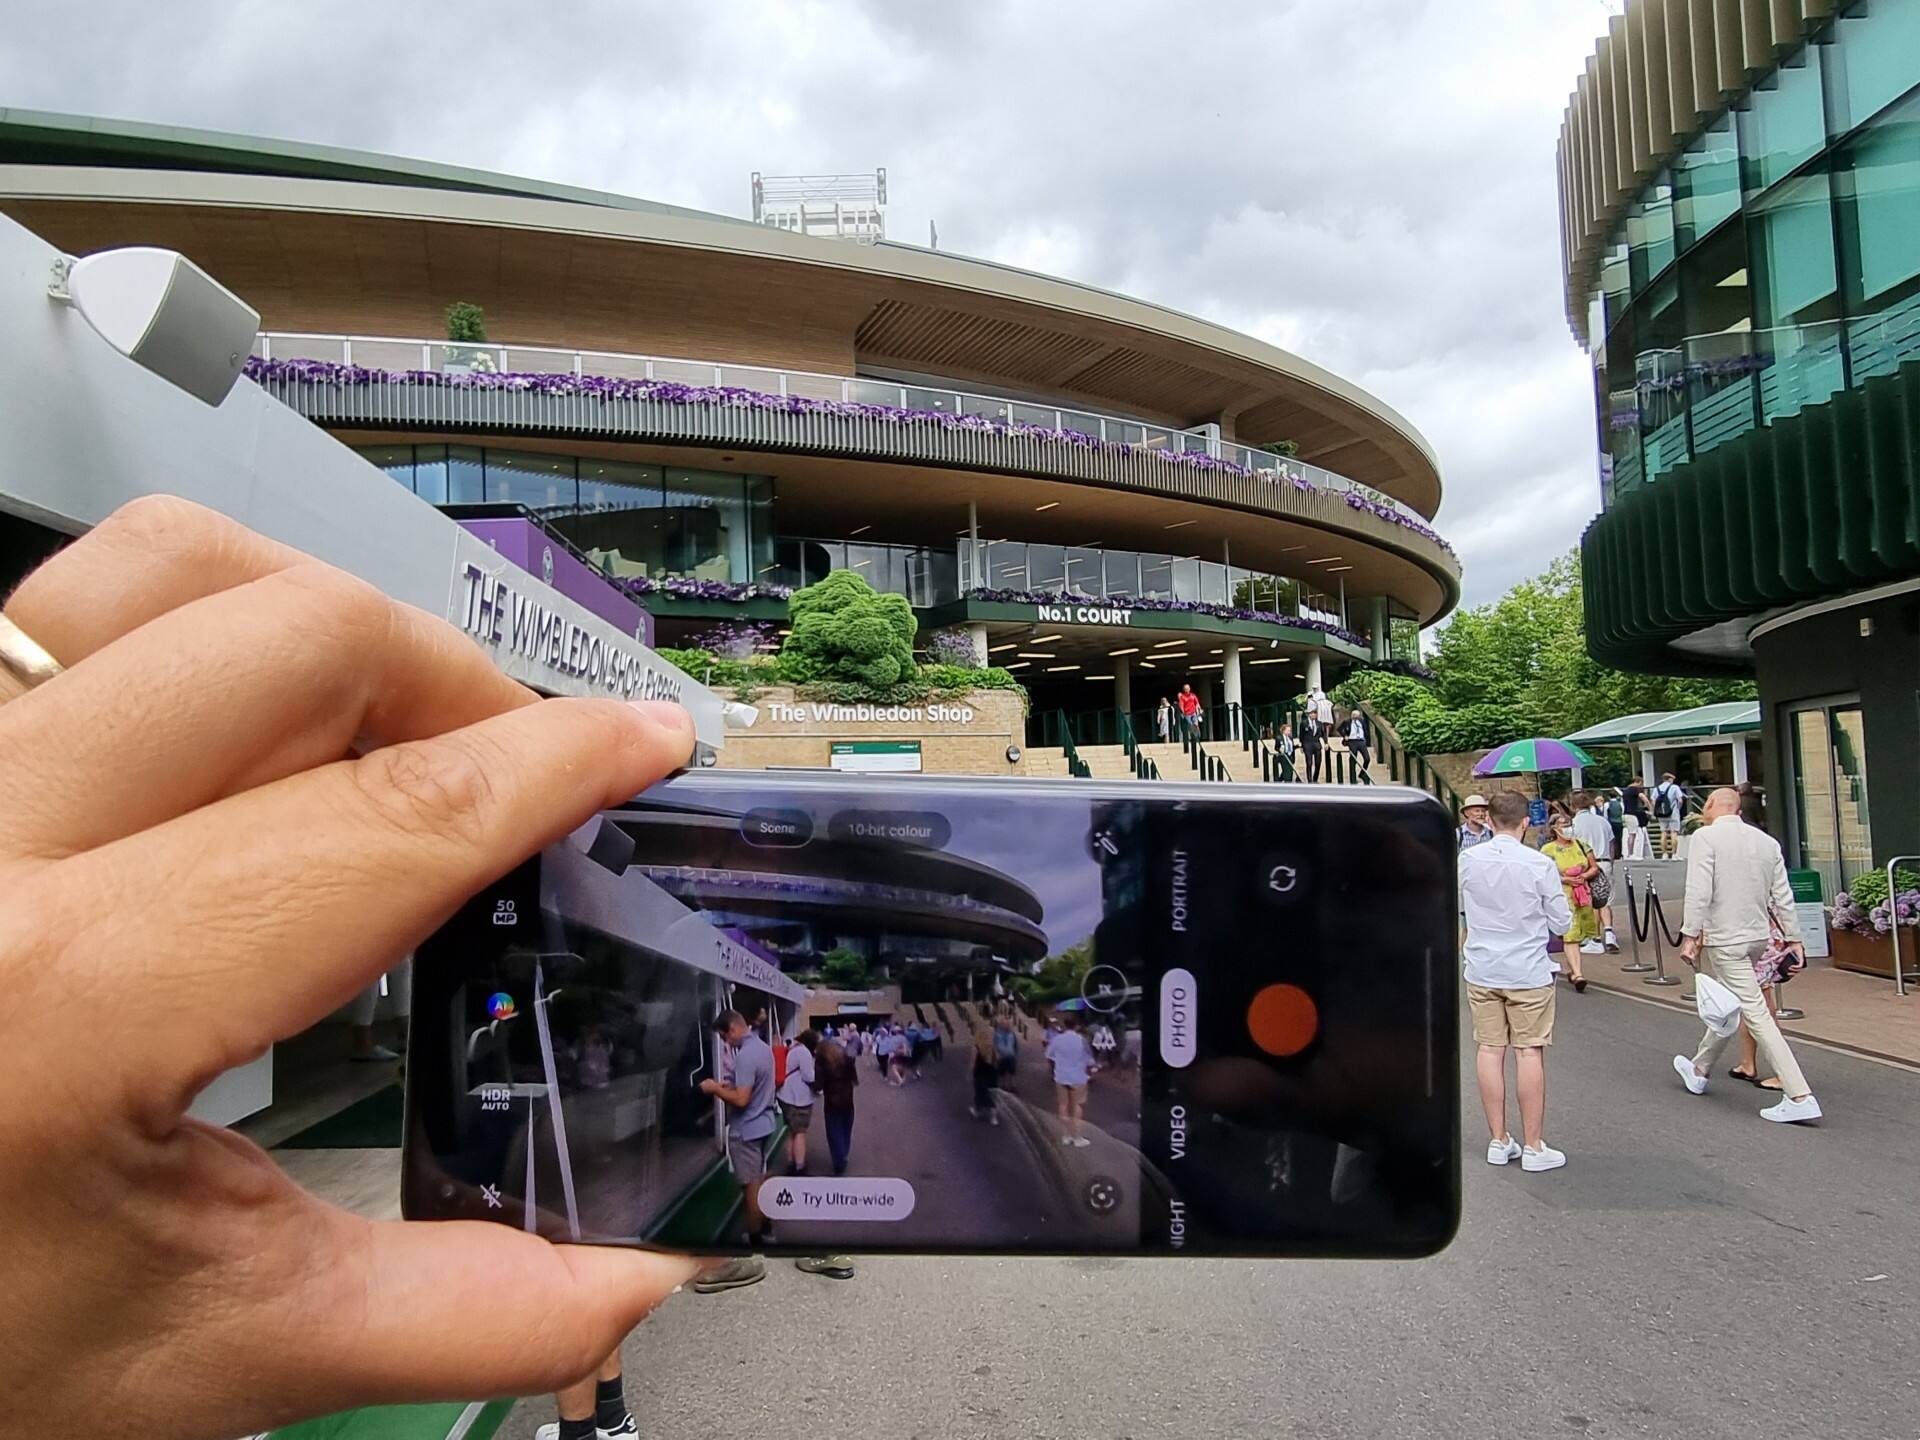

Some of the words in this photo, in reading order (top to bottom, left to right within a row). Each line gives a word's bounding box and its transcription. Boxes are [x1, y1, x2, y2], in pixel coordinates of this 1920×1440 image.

[1037, 605, 1072, 623] No.1
[1076, 606, 1132, 625] COURT
[464, 563, 509, 643] THE
[511, 592, 609, 688] WIMBLEDON
[768, 704, 806, 722] The
[811, 704, 923, 723] Wimbledon
[927, 705, 974, 725] Shop
[759, 821, 796, 835] Scene
[850, 823, 885, 837] 10-bit
[888, 826, 933, 839] colour
[1171, 851, 1188, 932] PORTRAIT
[496, 901, 515, 912] 50
[495, 914, 515, 924] MP
[1172, 988, 1187, 1048] PHOTO
[481, 1089, 511, 1101] HDR
[481, 1102, 509, 1111] AUTO
[1170, 1105, 1187, 1160] VIDEO
[802, 1192, 823, 1208] Try
[826, 1192, 895, 1206] Ultra-wide
